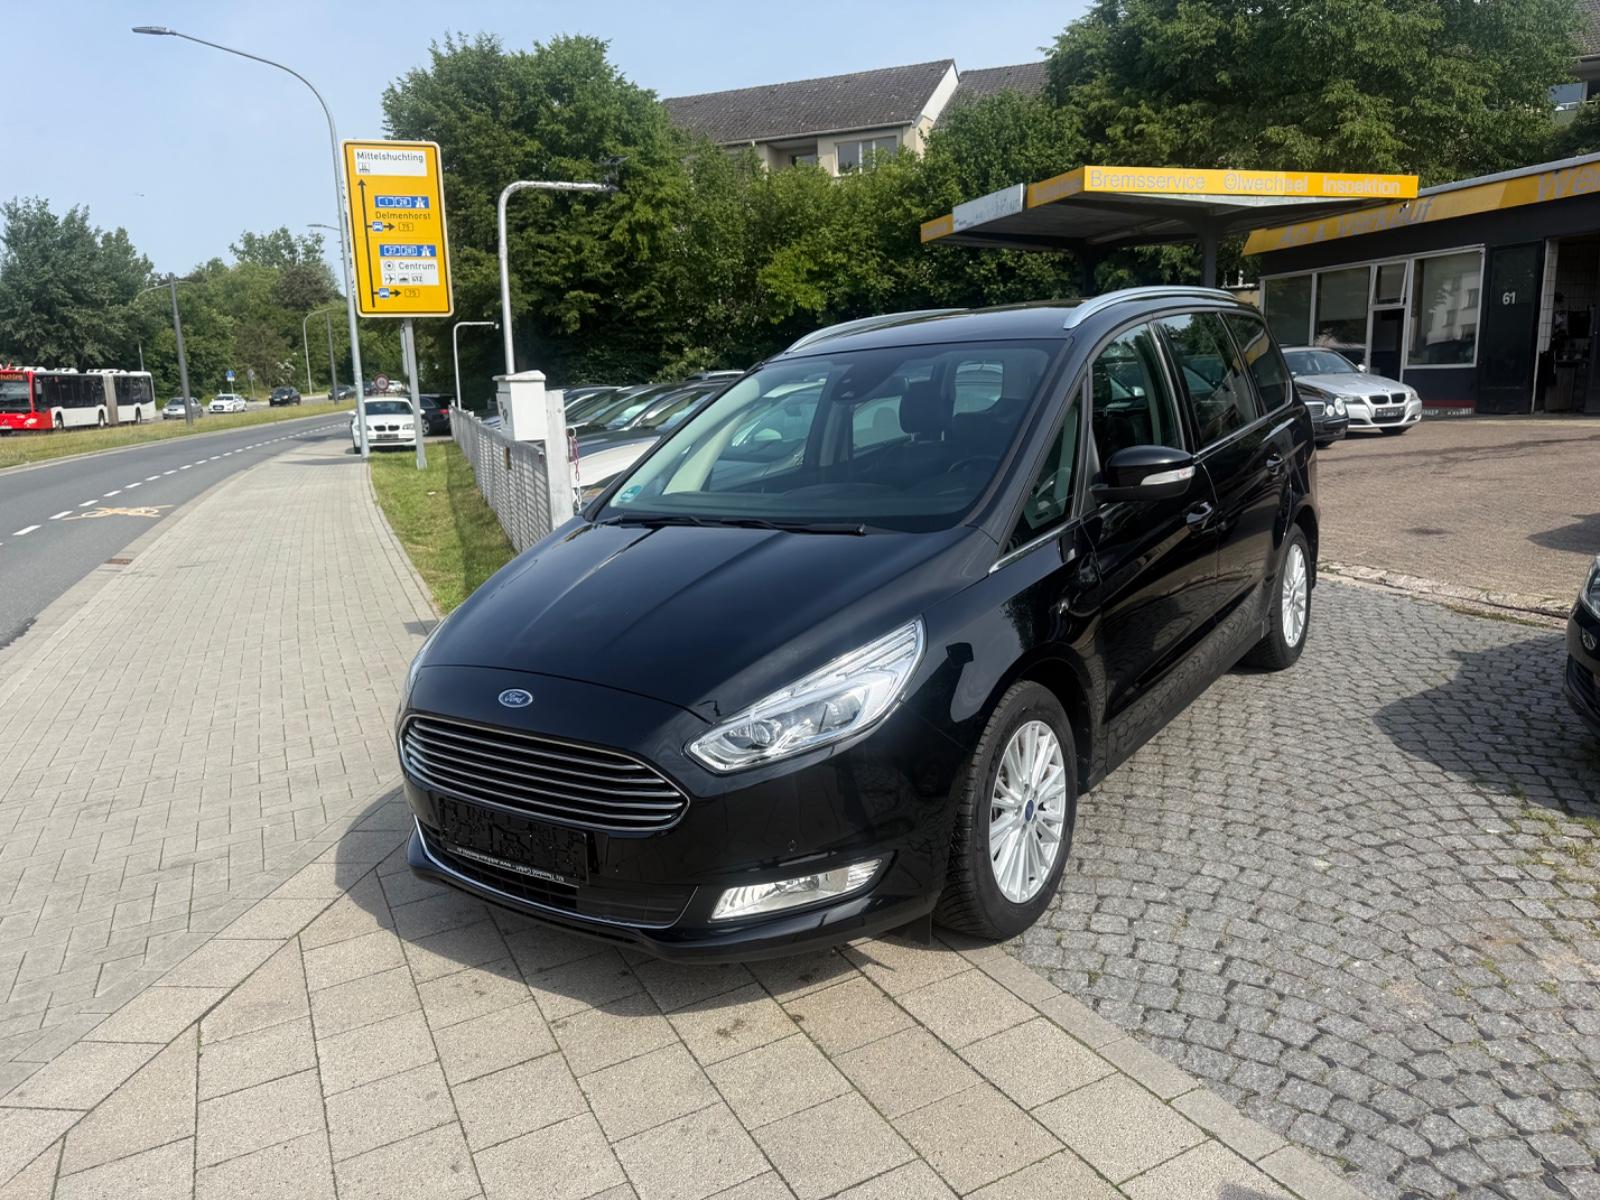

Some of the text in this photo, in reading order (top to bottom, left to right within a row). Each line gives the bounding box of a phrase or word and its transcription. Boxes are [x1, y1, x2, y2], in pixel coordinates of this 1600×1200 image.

[356, 151, 424, 163] Mittelshuchting
[1090, 169, 1207, 190] Bremsservice
[1322, 176, 1401, 195] Inspektion
[375, 211, 431, 220] Delmenhorst
[398, 261, 436, 270] Centrum
[1502, 291, 1516, 306] 61
[504, 691, 526, 704] Ford
